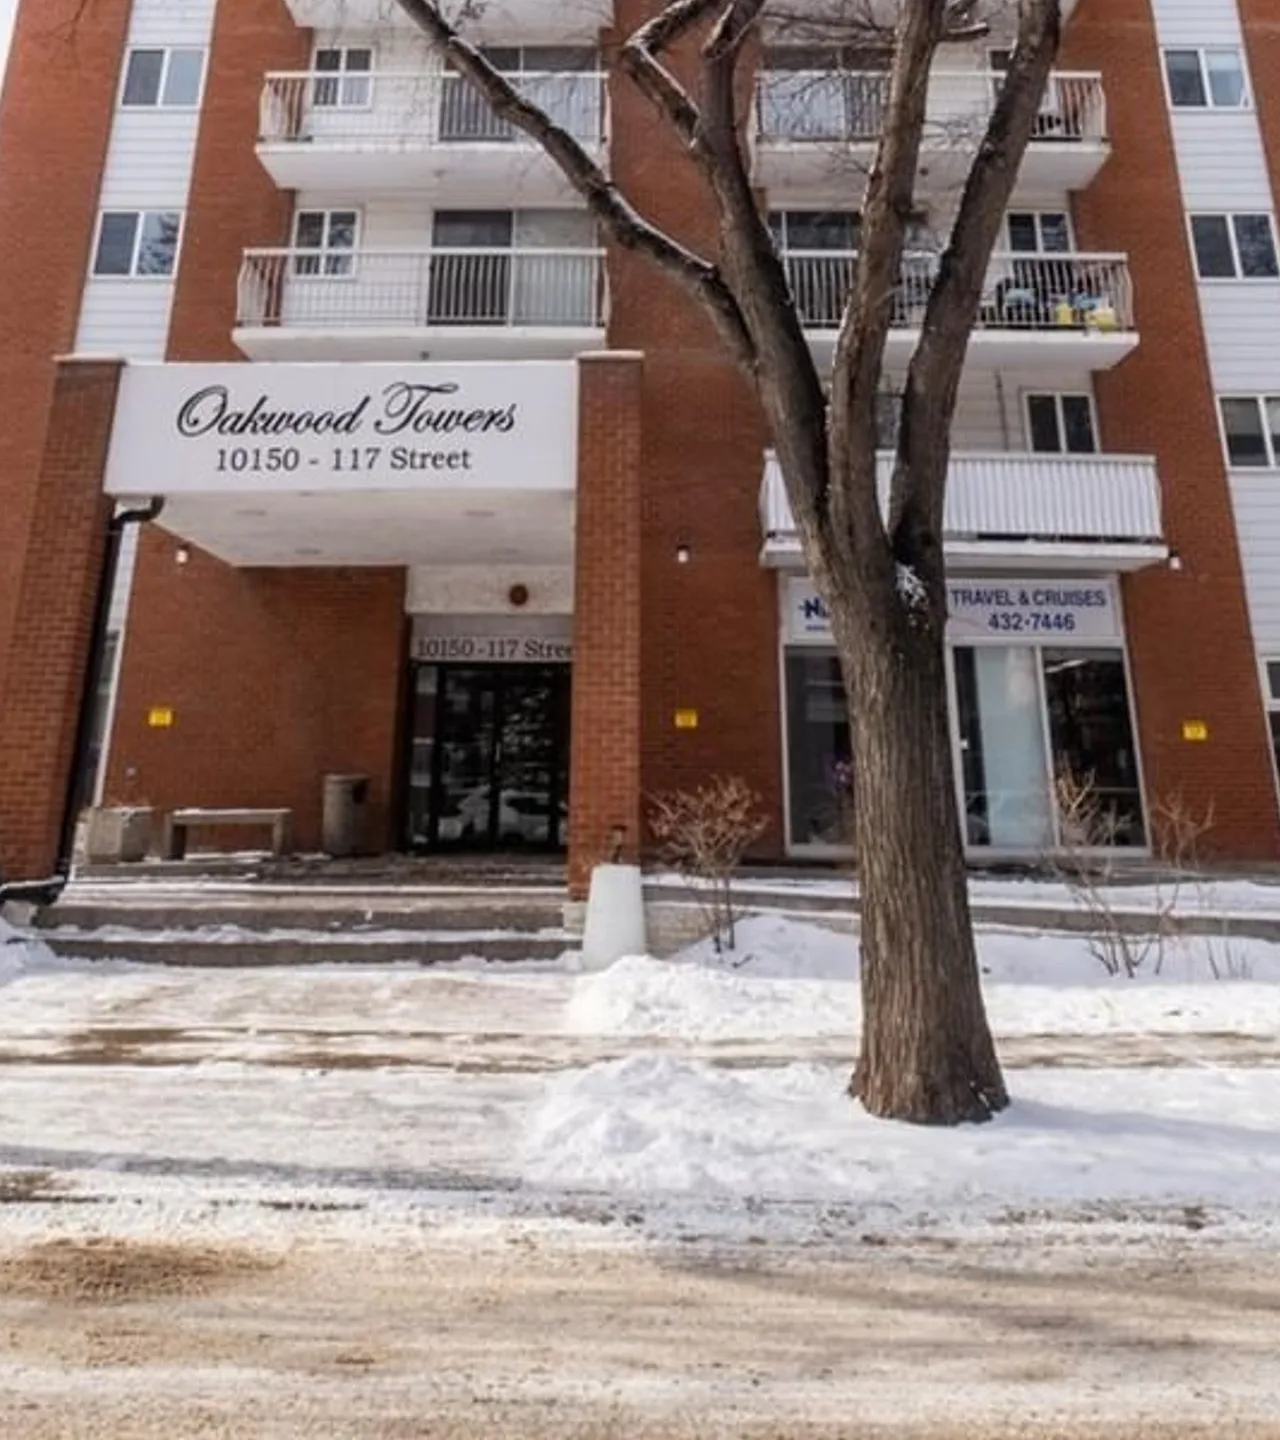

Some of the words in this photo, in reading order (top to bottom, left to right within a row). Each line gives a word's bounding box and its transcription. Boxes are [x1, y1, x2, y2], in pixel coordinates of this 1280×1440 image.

[177, 385, 371, 437] Oakwood
[373, 381, 517, 435] Towers
[216, 447, 300, 472] 10150
[331, 447, 382, 471] 117
[390, 446, 472, 471] Street
[950, 589, 1015, 607] TRAVEL
[1018, 590, 1030, 607] &
[1032, 589, 1106, 607] CRUISES
